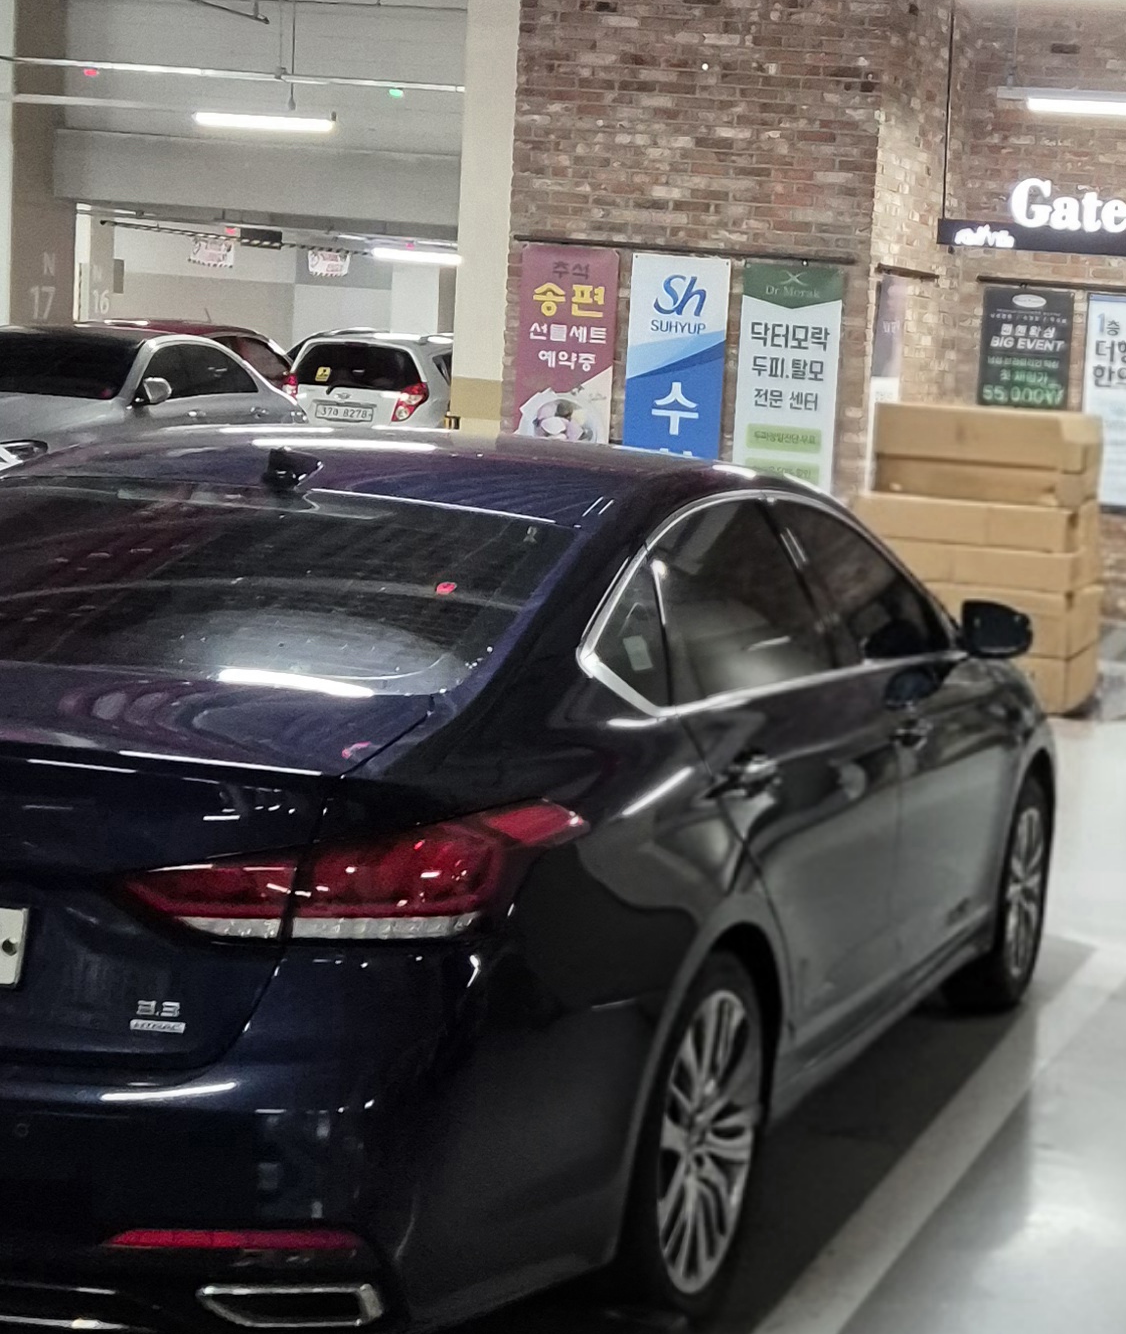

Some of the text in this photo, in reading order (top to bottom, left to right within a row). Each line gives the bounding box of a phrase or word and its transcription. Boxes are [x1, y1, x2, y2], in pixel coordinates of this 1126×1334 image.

[43, 252, 56, 276] N
[552, 260, 590, 280] 추석
[30, 286, 56, 320] 17
[93, 289, 110, 315] 16
[533, 282, 605, 318] 송편
[653, 274, 707, 317] Sh
[529, 322, 607, 344] 선물세트
[650, 319, 707, 335] SUHYUP
[1097, 312, 1120, 336] 1층
[751, 321, 831, 352] 닥터모락
[990, 336, 1065, 352] BIG EVENT
[538, 350, 596, 372] 예약중
[754, 388, 818, 411] 전문 센터
[651, 382, 699, 457] 수
